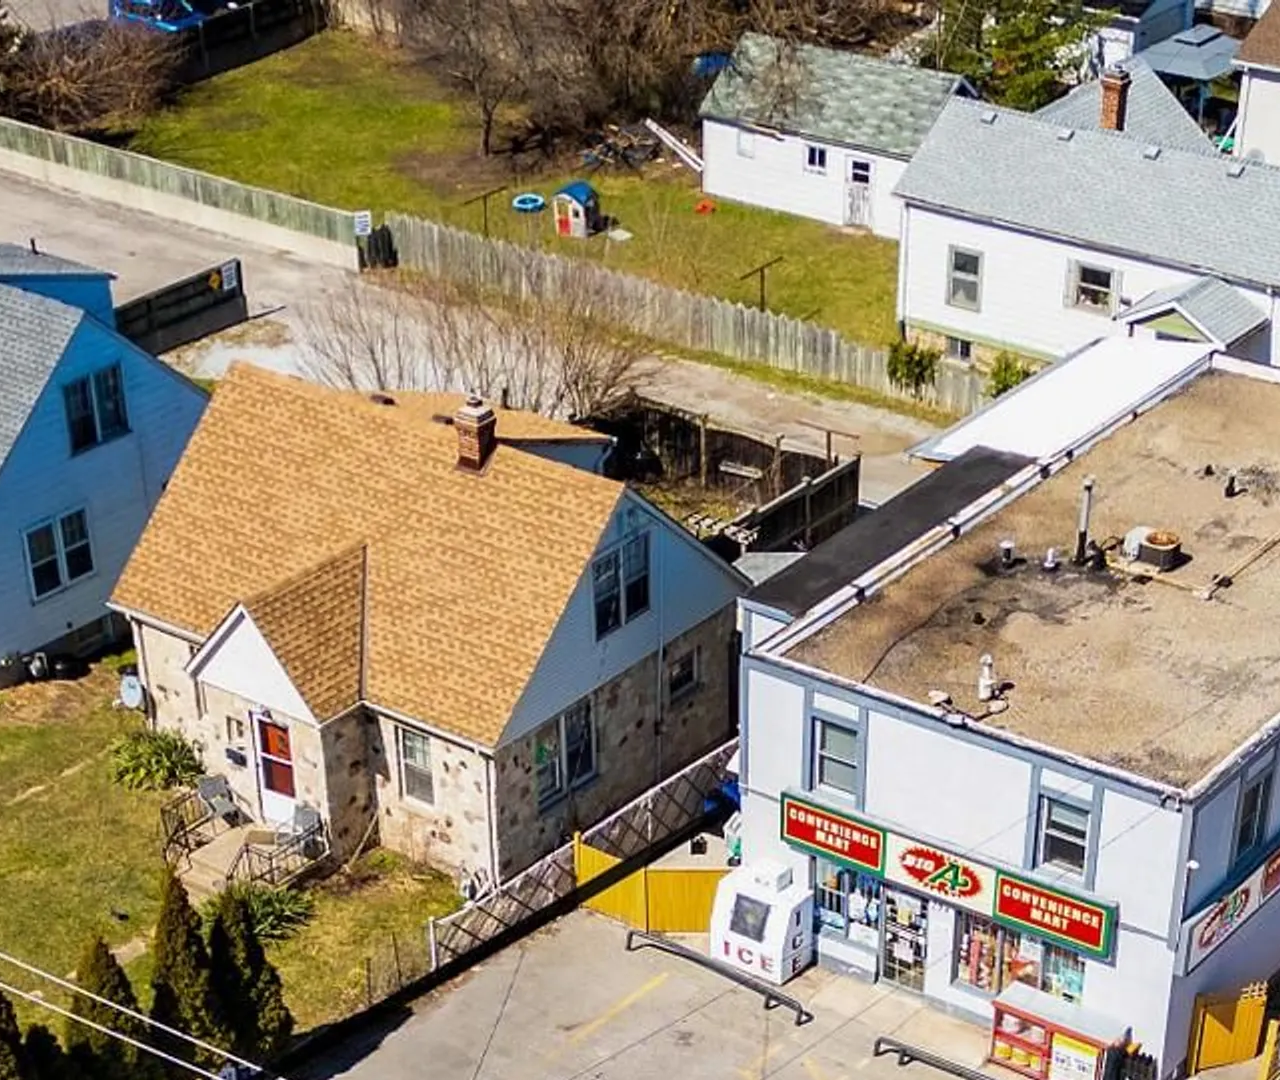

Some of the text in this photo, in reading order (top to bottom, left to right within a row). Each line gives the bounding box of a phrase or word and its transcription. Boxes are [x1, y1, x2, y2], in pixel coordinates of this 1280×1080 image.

[789, 808, 878, 849] CONVENIENCE
[816, 829, 850, 852] MART
[1002, 884, 1100, 929] CONVENIENCE
[1030, 908, 1069, 931] MART
[724, 940, 774, 973] ICE
